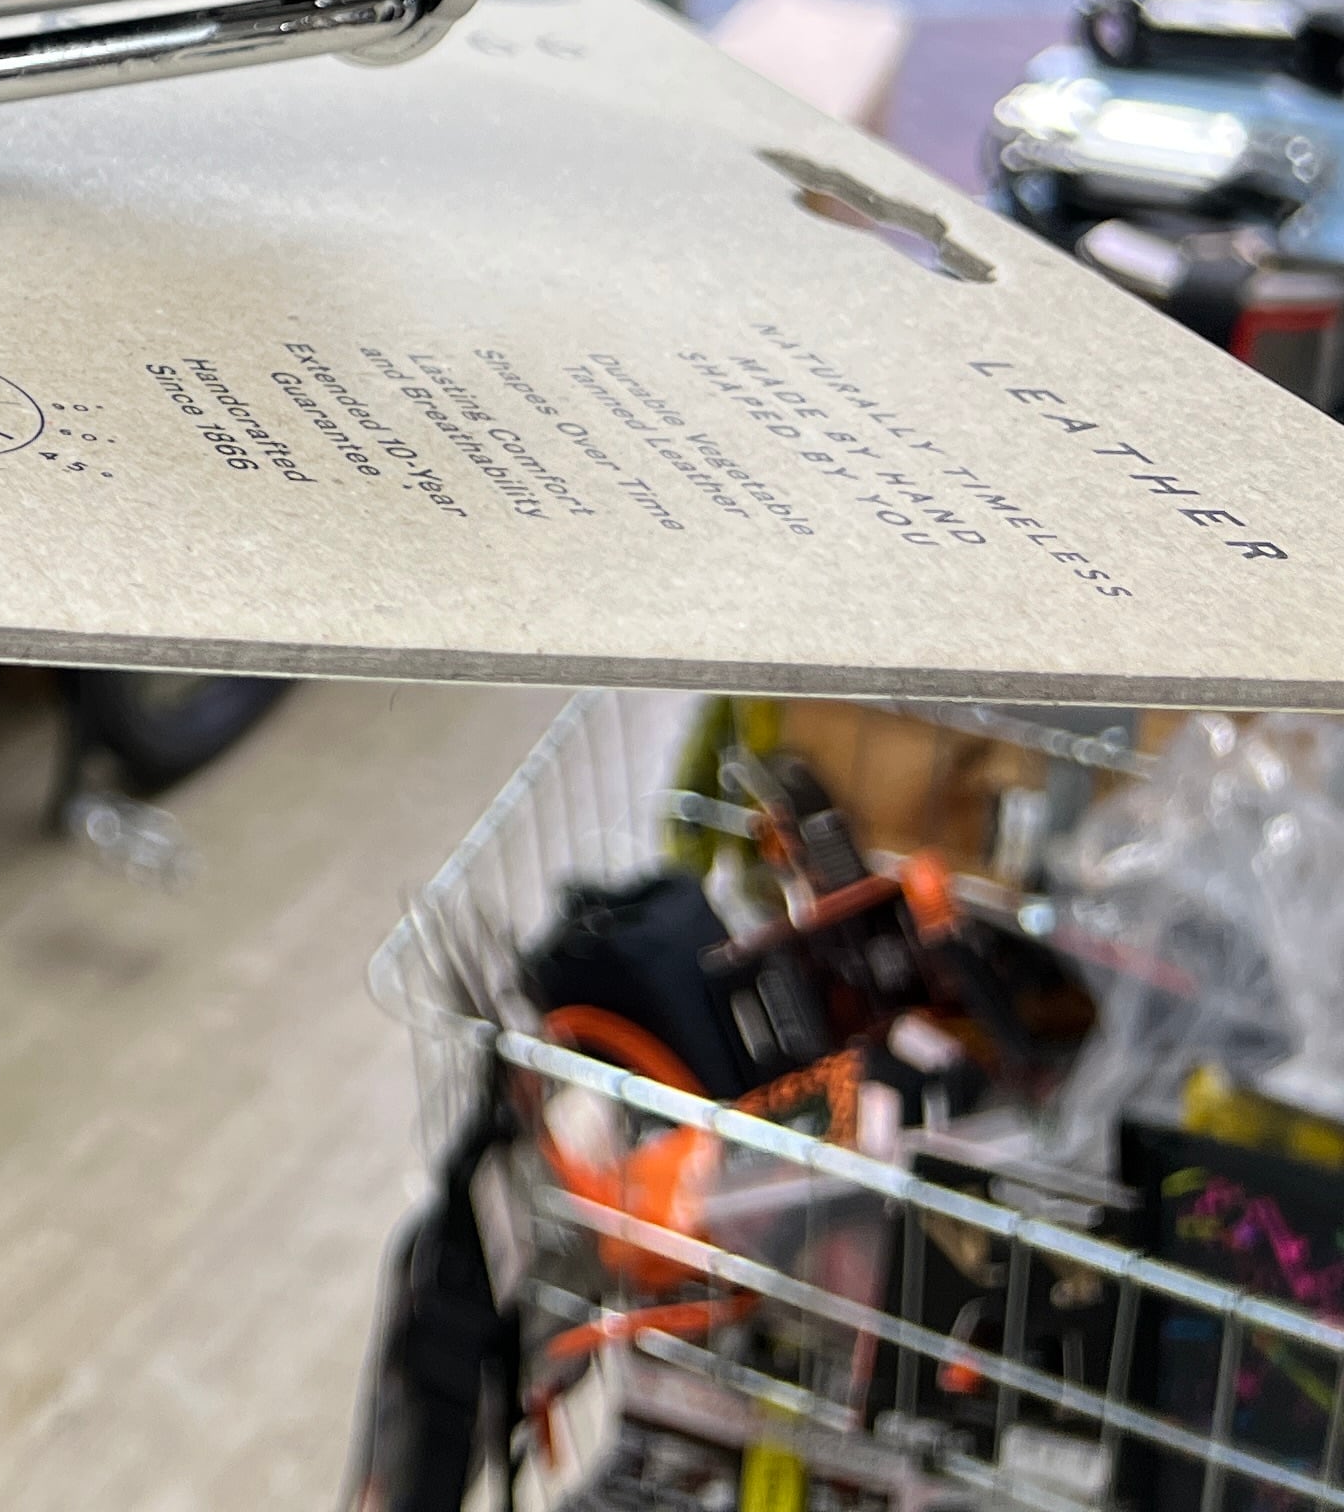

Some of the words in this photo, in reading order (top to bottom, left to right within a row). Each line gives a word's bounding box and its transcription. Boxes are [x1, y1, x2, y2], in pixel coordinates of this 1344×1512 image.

[146, 363, 205, 416] Since
[197, 424, 259, 471] 1866
[182, 357, 317, 483] Handcrafted
[271, 371, 381, 477] Guarantee
[283, 342, 393, 431] Extended
[378, 438, 468, 518] 10-Year
[359, 346, 414, 381] and
[400, 387, 550, 520] Breathability
[406, 354, 492, 422] Lasting
[488, 428, 597, 517] Comfort
[474, 349, 559, 417] Shapes
[556, 422, 621, 472] Over
[618, 477, 685, 531] Time
[562, 364, 658, 432] Tanned
[645, 437, 750, 520] Leather
[587, 354, 686, 427] Durable
[685, 433, 814, 536] Vegetable
[677, 350, 801, 439] SHAPED
[801, 451, 859, 481] BY
[856, 493, 940, 546] YOU
[729, 356, 828, 419] MADE
[824, 431, 881, 459] BY
[876, 471, 986, 544] HAND
[751, 323, 944, 455] NATURALLY
[943, 465, 1132, 598] TIMELESS
[968, 361, 1289, 560] LEATHER
